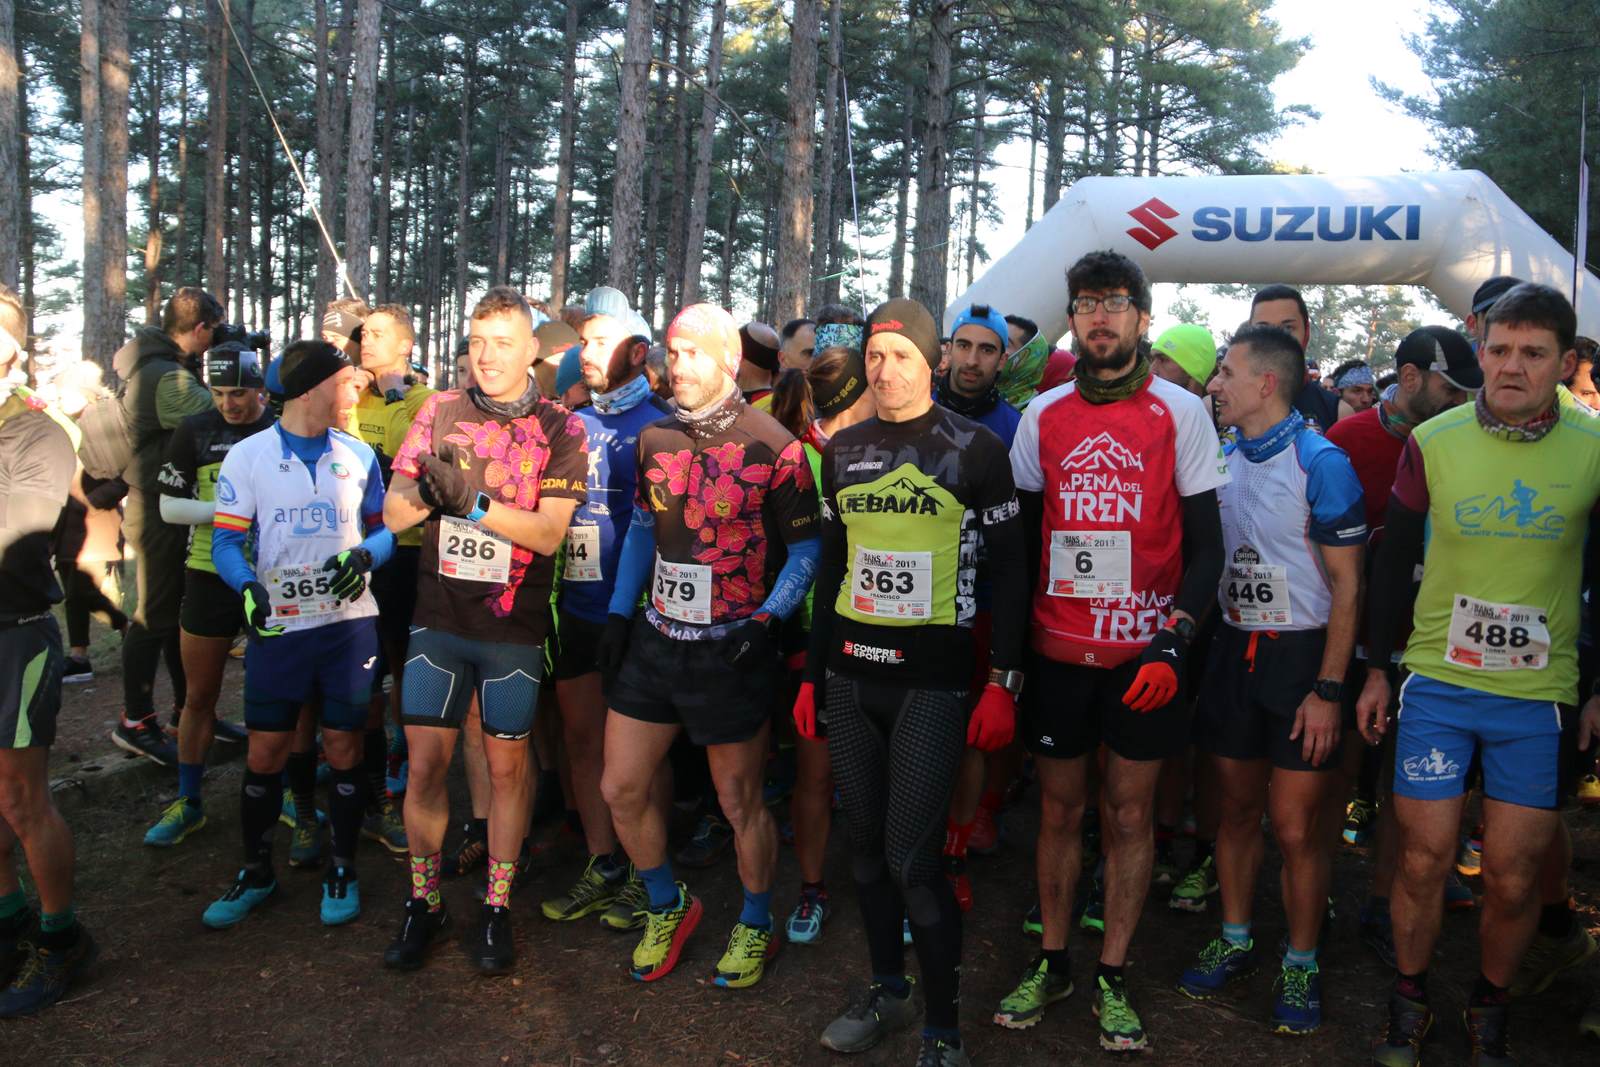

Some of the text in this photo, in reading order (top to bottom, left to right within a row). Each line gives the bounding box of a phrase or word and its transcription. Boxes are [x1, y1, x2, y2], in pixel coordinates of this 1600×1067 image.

[1192, 205, 1421, 242] SUZUKI
[540, 478, 567, 490] CDM
[1059, 481, 1071, 491] LA
[1123, 483, 1143, 493] DEL
[1059, 491, 1143, 523] TREN
[446, 534, 496, 561] 286
[1075, 551, 1093, 574] 6
[281, 576, 330, 599] 365
[657, 575, 696, 602] 379
[860, 568, 914, 595] 363
[1228, 582, 1274, 604] 446
[669, 628, 703, 641] MAX
[1465, 621, 1530, 648] 488
[852, 650, 887, 664] SPORT
